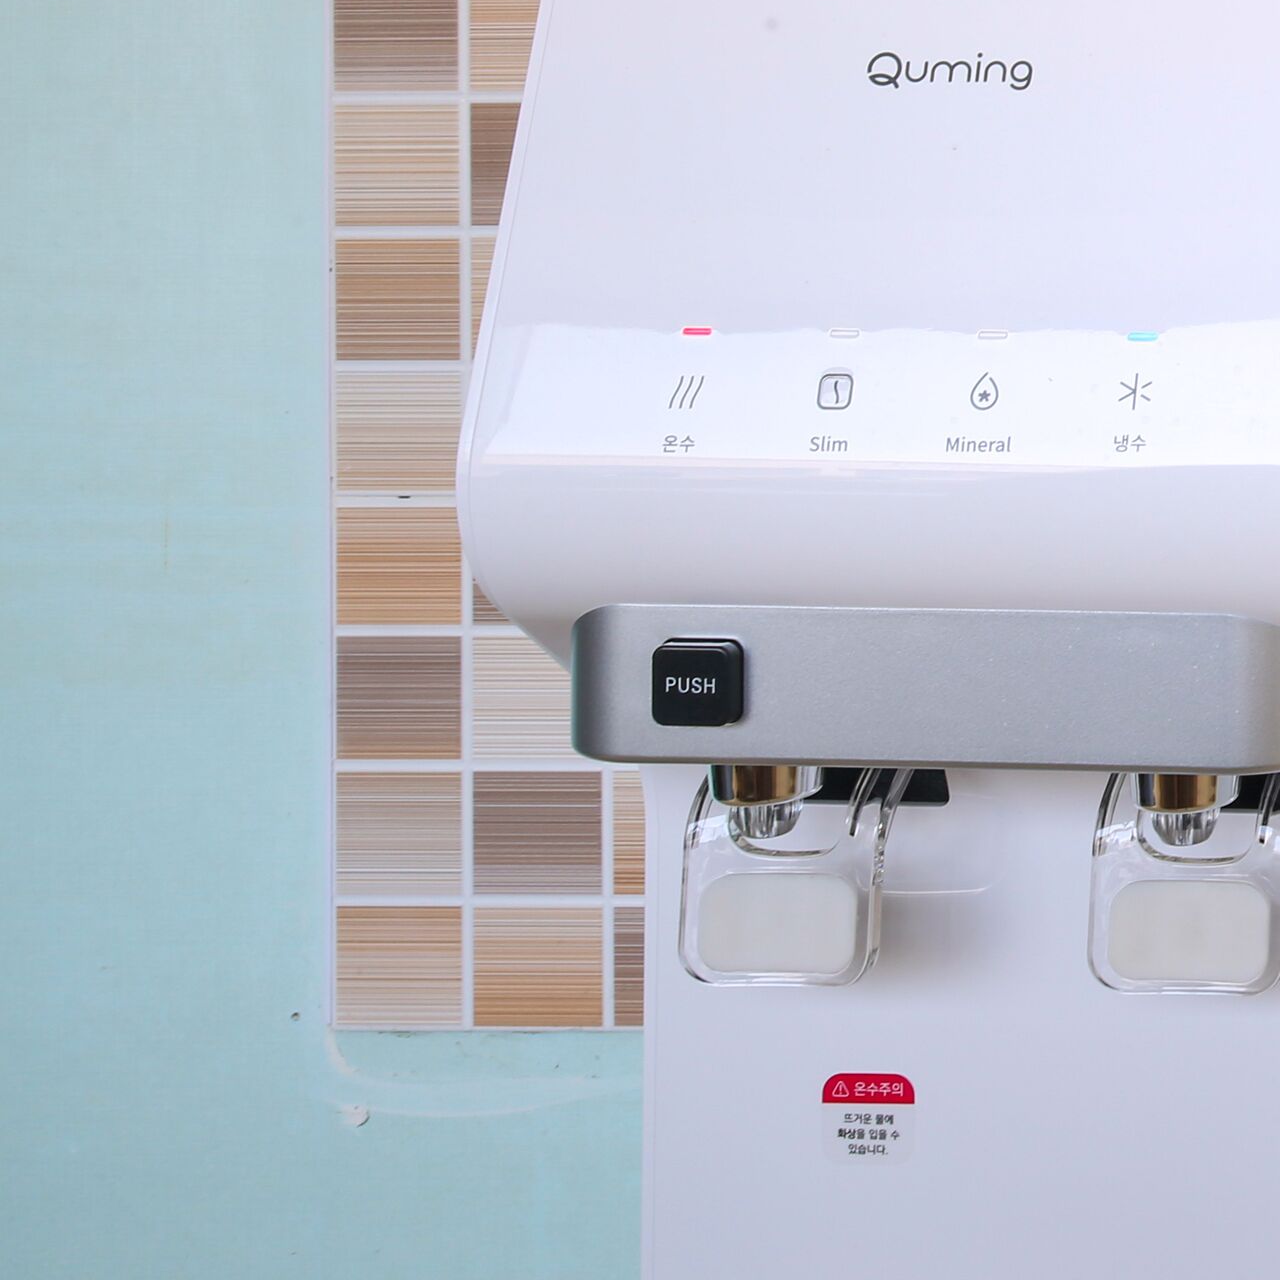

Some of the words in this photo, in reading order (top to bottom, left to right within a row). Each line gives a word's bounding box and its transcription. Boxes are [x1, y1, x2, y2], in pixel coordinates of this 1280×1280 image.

[866, 51, 1034, 91] Quming
[661, 434, 696, 454] 온수
[808, 436, 849, 453] Slim
[944, 436, 1012, 454] Mineral
[1113, 434, 1147, 453] 냉수
[664, 675, 717, 695] PUSH
[854, 1081, 905, 1097] 온수주의
[844, 1113, 873, 1125] 뜨거운
[875, 1114, 895, 1125] 물에
[837, 1128, 866, 1140] 화상을
[868, 1128, 887, 1140] 입을
[890, 1129, 900, 1141] 수
[848, 1143, 889, 1156] 있습니다.
